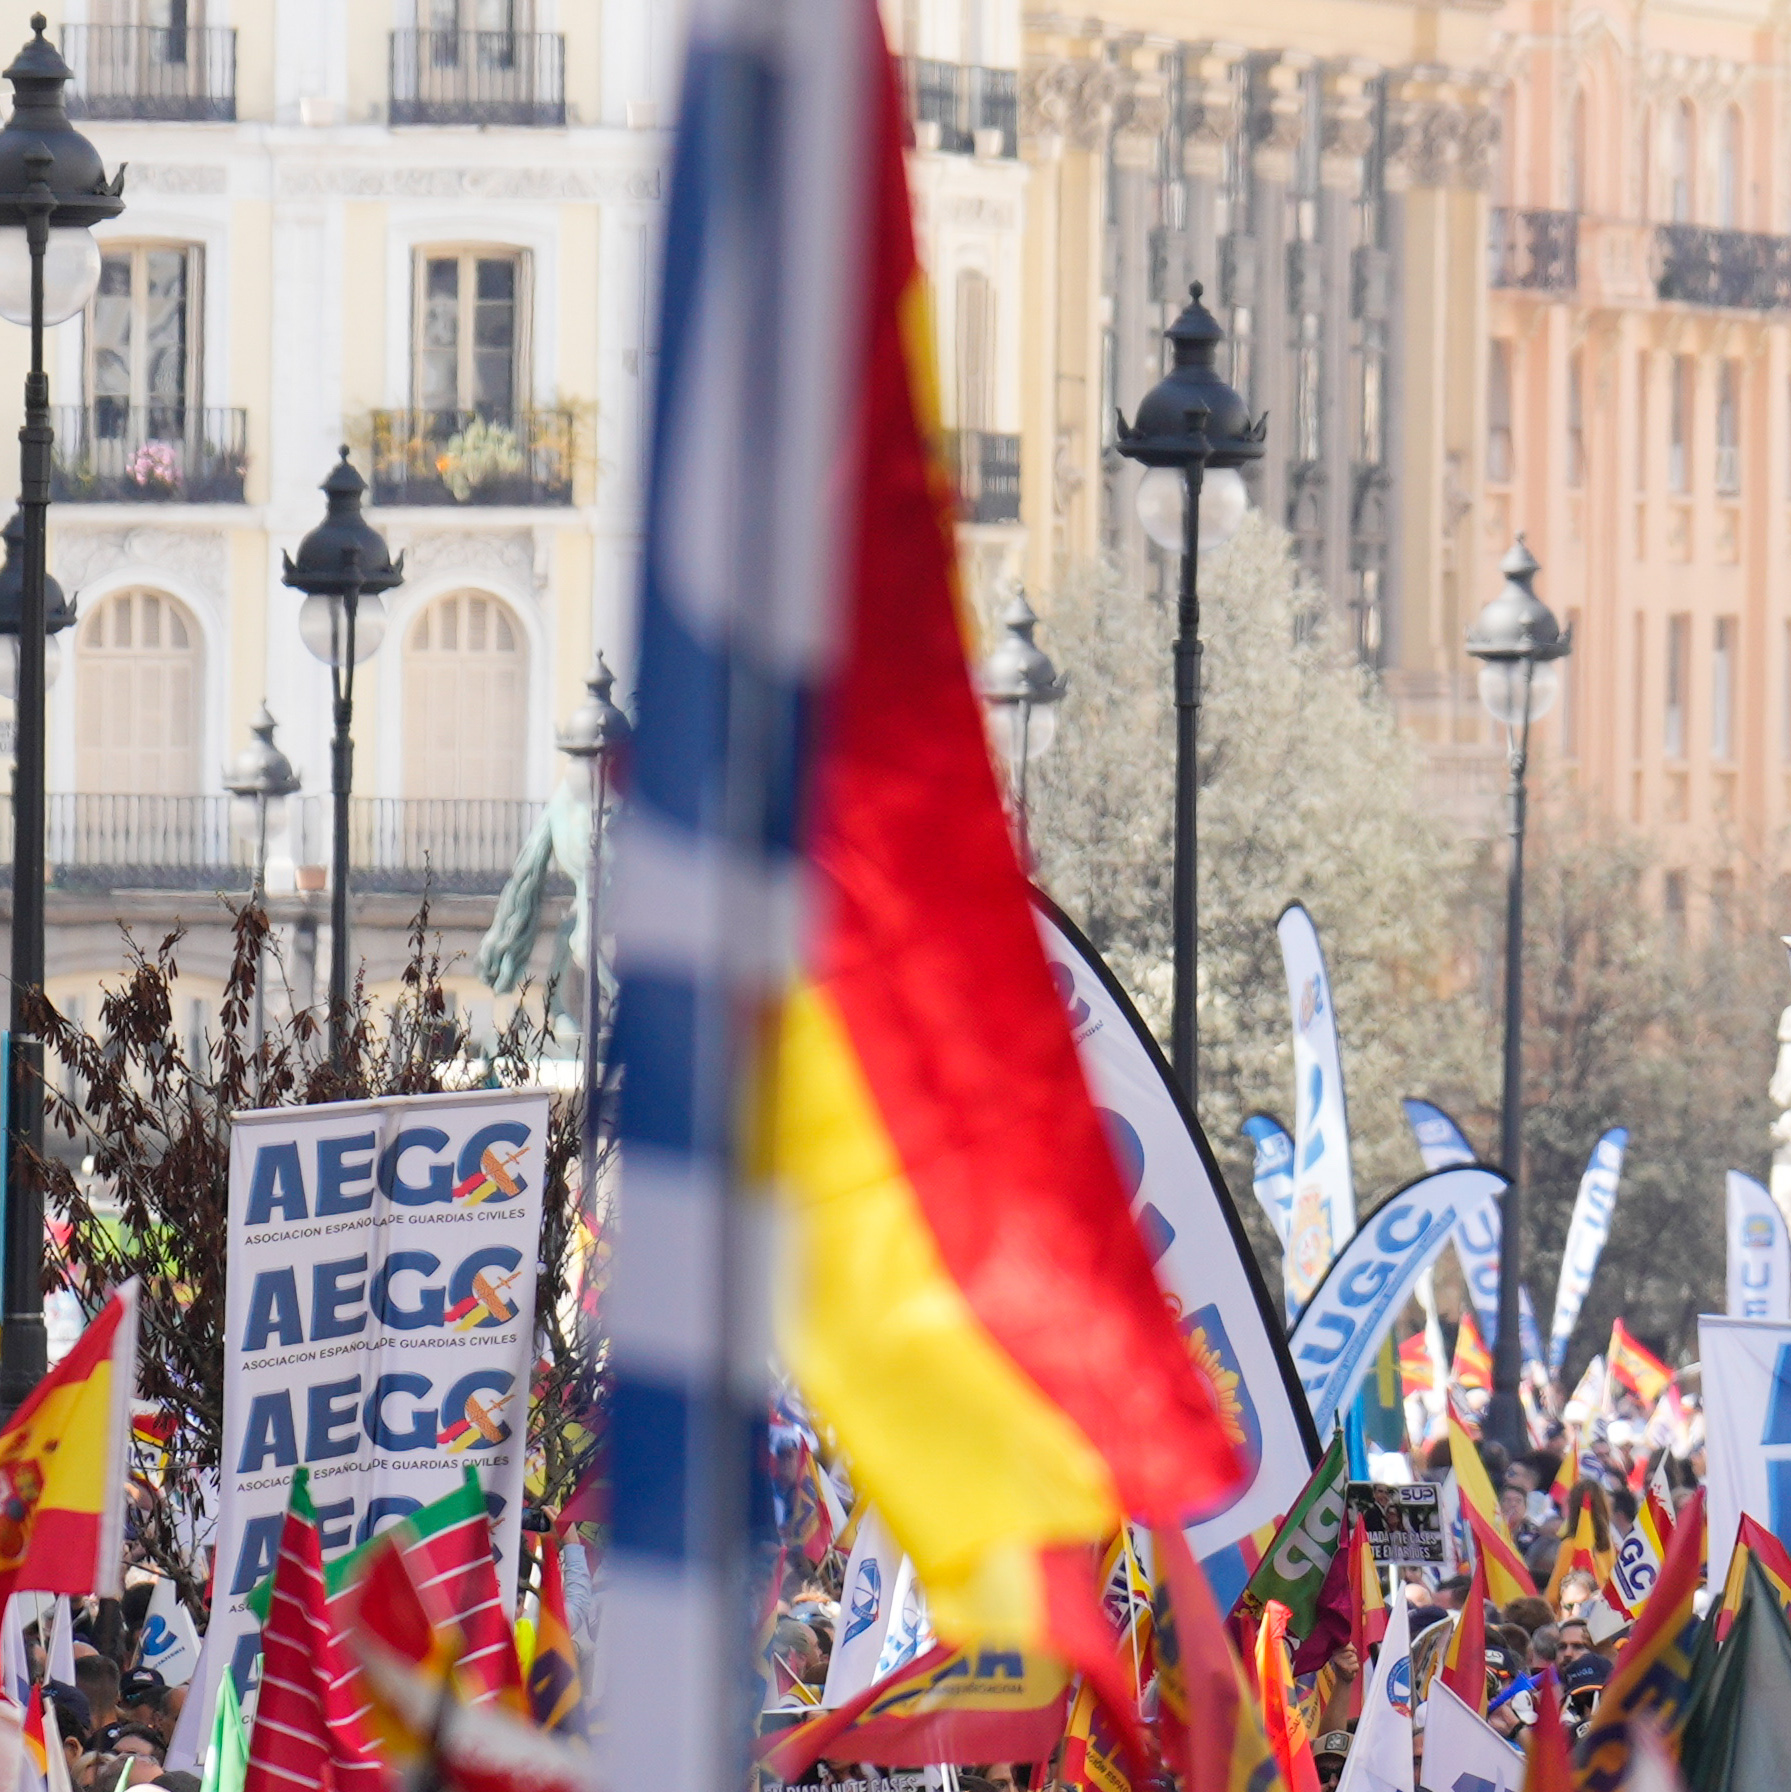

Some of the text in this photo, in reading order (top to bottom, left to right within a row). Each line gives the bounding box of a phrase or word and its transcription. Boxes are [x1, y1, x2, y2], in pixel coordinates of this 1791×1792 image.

[244, 1119, 532, 1227] AEGC
[244, 1227, 322, 1246] ASOCIACION
[408, 1211, 473, 1226] GUARDIAS
[477, 1207, 527, 1222] CIVILES
[241, 1244, 523, 1352] AEGC
[1300, 1203, 1433, 1382] UGC
[241, 1351, 317, 1371] ASOCIACION
[400, 1335, 466, 1350] GUARDIAS
[469, 1333, 518, 1347] CIVILES
[236, 1368, 516, 1475] AEGC
[236, 1474, 312, 1493] ASOCIAC
[393, 1457, 459, 1471] GUARDIAS
[1401, 1488, 1434, 1501] SUP
